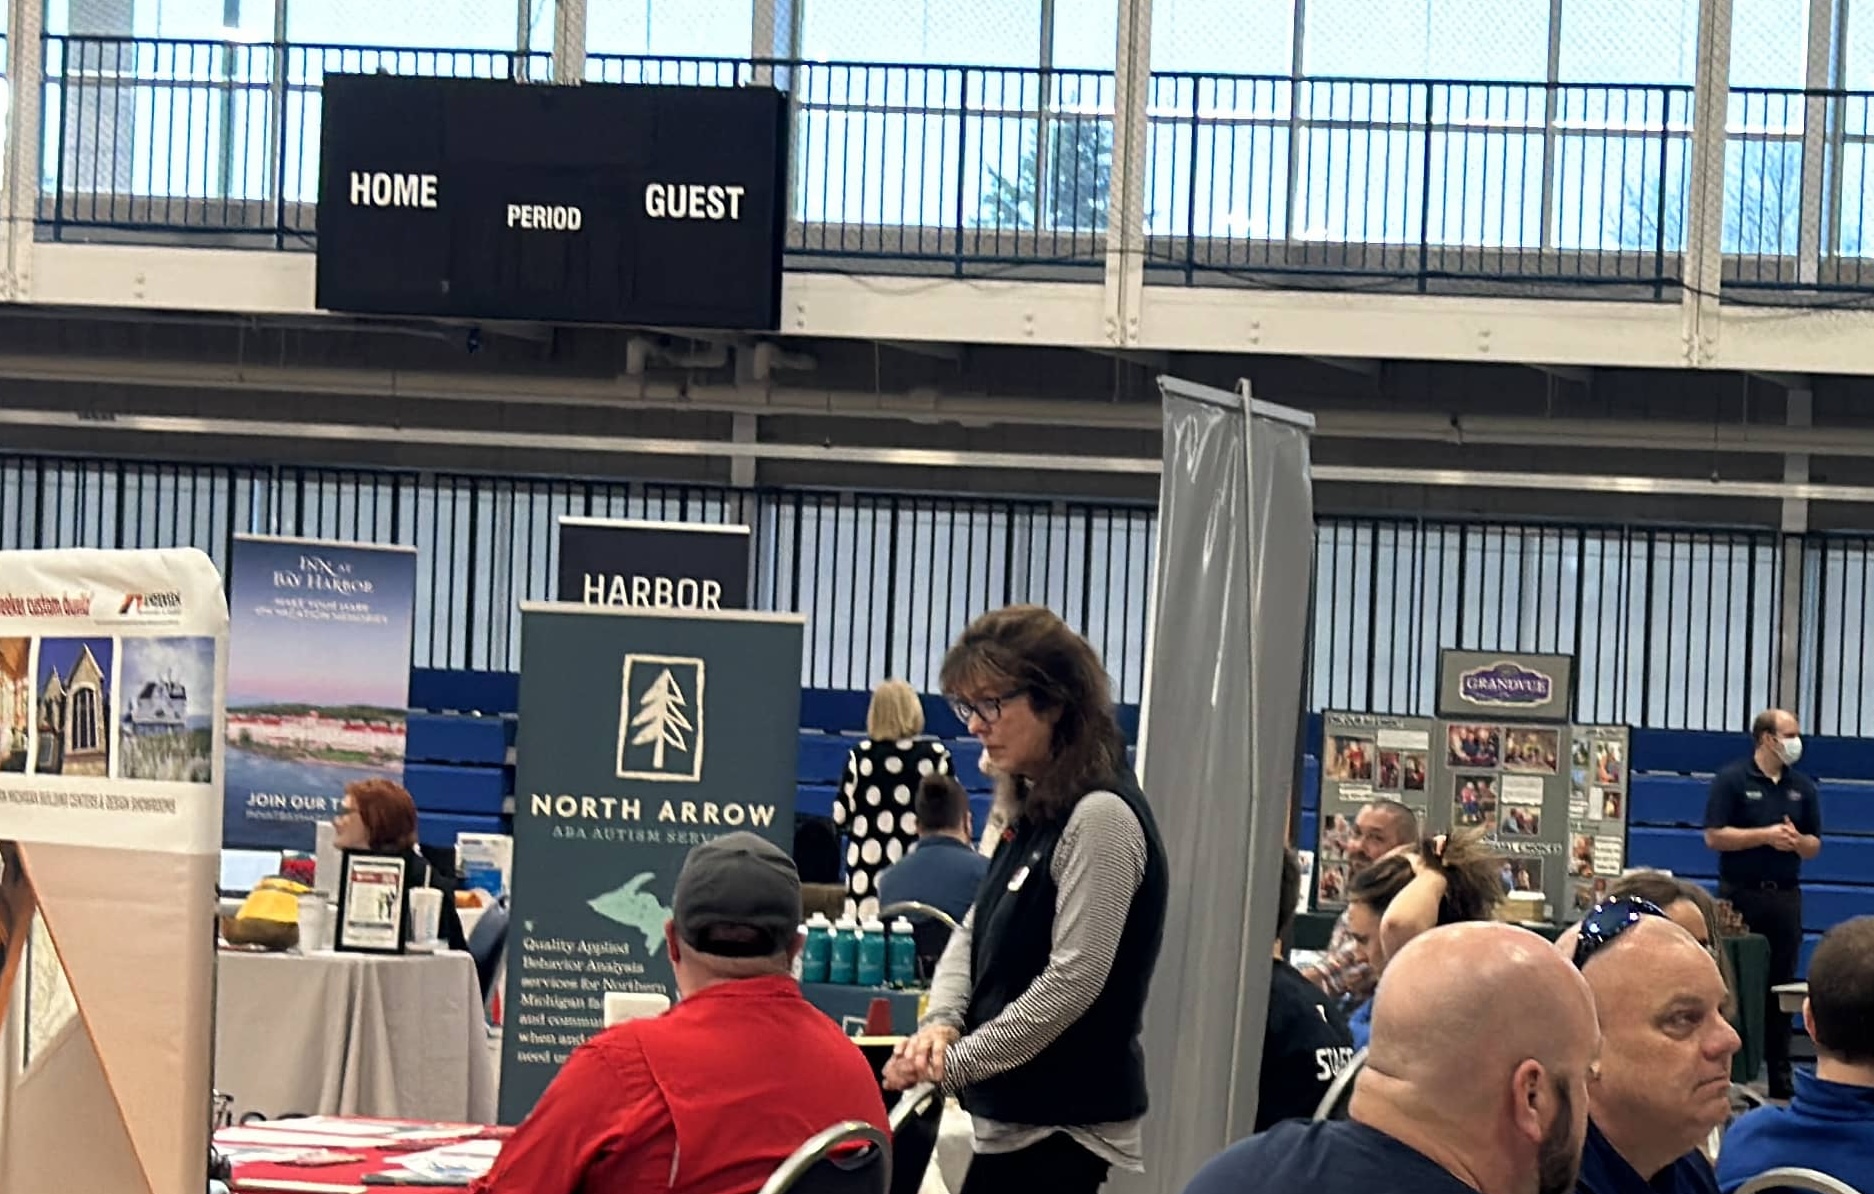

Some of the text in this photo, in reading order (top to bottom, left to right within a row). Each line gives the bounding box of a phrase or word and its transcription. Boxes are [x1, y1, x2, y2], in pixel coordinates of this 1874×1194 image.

[350, 171, 438, 207] HOME
[644, 183, 746, 220] GUEST
[506, 203, 582, 231] PERIOD
[306, 574, 374, 594] HARBOR
[583, 573, 722, 611] HARBOR
[1466, 677, 1547, 693] GRANDVUE
[246, 792, 287, 809] JOIN
[290, 794, 327, 811] OUR
[530, 793, 776, 828] NORTH ARROW
[552, 825, 587, 840] ABA
[592, 827, 660, 844] AUTISM
[522, 937, 630, 956] Quality Applied
[522, 955, 645, 975] Behavior Analysis
[520, 977, 667, 993] services for Northern
[519, 993, 585, 1009] Michigan
[518, 1013, 546, 1026] and
[518, 1032, 586, 1046] when and
[517, 1050, 550, 1064] need
